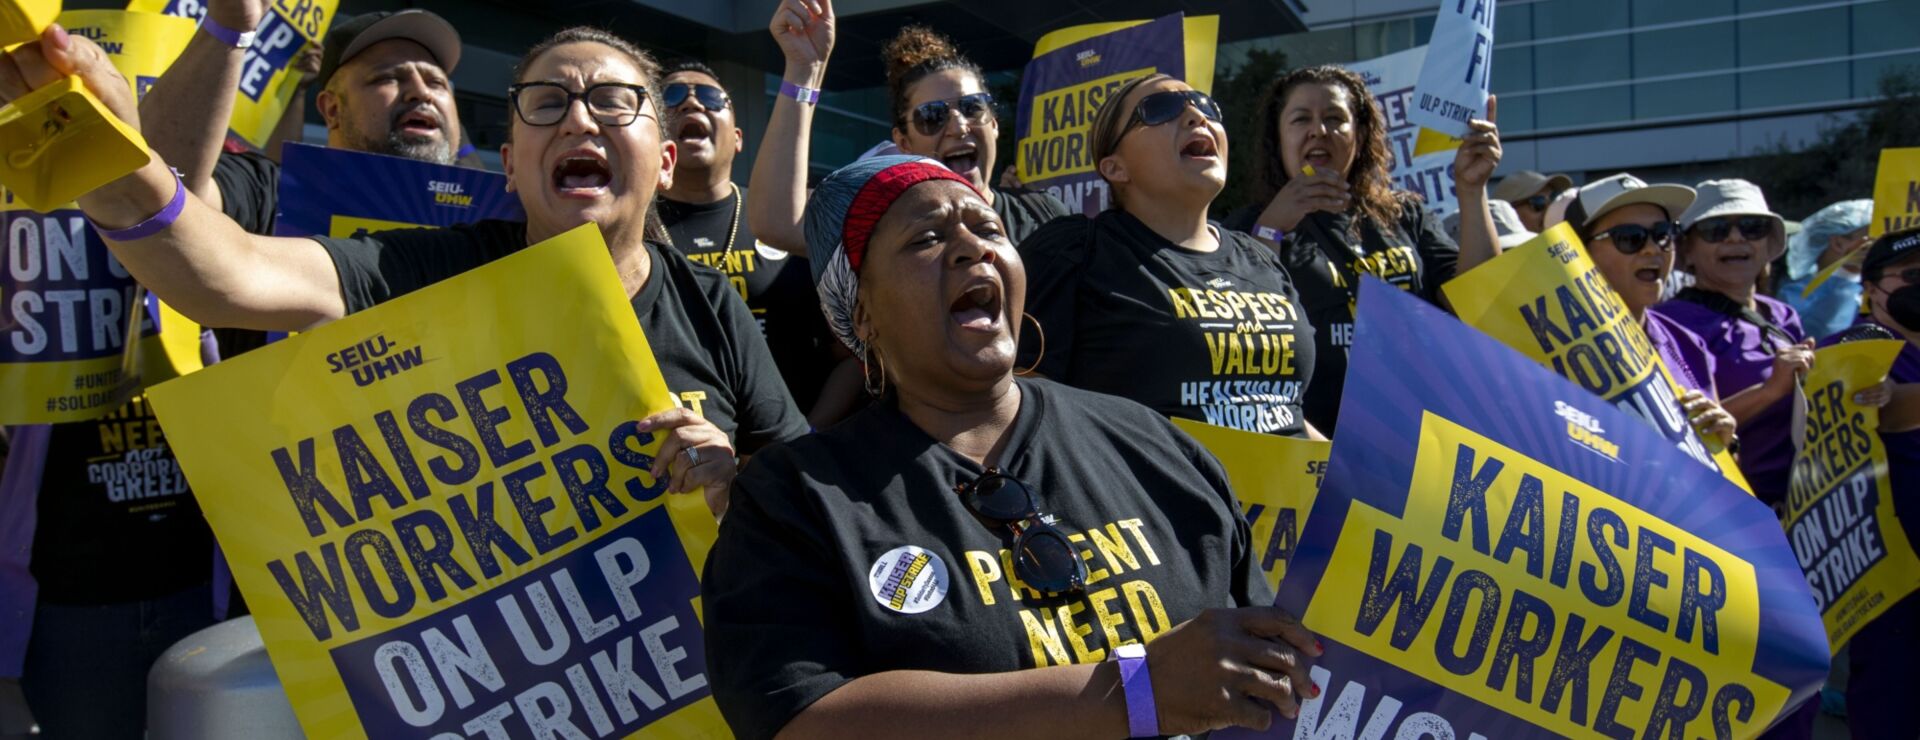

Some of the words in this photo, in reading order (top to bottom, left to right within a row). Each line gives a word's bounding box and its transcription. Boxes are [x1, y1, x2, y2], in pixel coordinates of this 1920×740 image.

[253, 10, 294, 54] LP
[1420, 93, 1440, 112] ULP
[427, 180, 464, 194] SEIU-
[434, 192, 472, 206] UHW
[9, 216, 89, 282] ON
[1168, 286, 1298, 321] RESPECT
[1236, 315, 1264, 334] and
[326, 335, 396, 374] SEIU-
[351, 346, 424, 387] UHW
[1204, 332, 1295, 375] VALUE
[1181, 381, 1302, 406] HEALTHCARE
[1804, 379, 1846, 443] SER
[99, 420, 167, 454] NEE
[1201, 402, 1294, 433] WORKERS
[1554, 400, 1605, 433] SEIU-
[271, 352, 589, 538] KAISER
[1567, 421, 1619, 459] UHW
[106, 474, 188, 502] GREED
[266, 420, 670, 642] WORKERS
[1793, 507, 1827, 569] ON
[1824, 472, 1868, 539] ULP
[1441, 442, 1726, 656] KAISER
[1806, 515, 1881, 615] STRIKE
[878, 552, 916, 601] KAISER
[889, 587, 907, 610] ULP
[901, 552, 932, 589] STRIKE
[374, 615, 506, 727] ON
[498, 537, 650, 667] ULP
[1019, 579, 1171, 668] NEED
[1354, 528, 1755, 740] WORKERS
